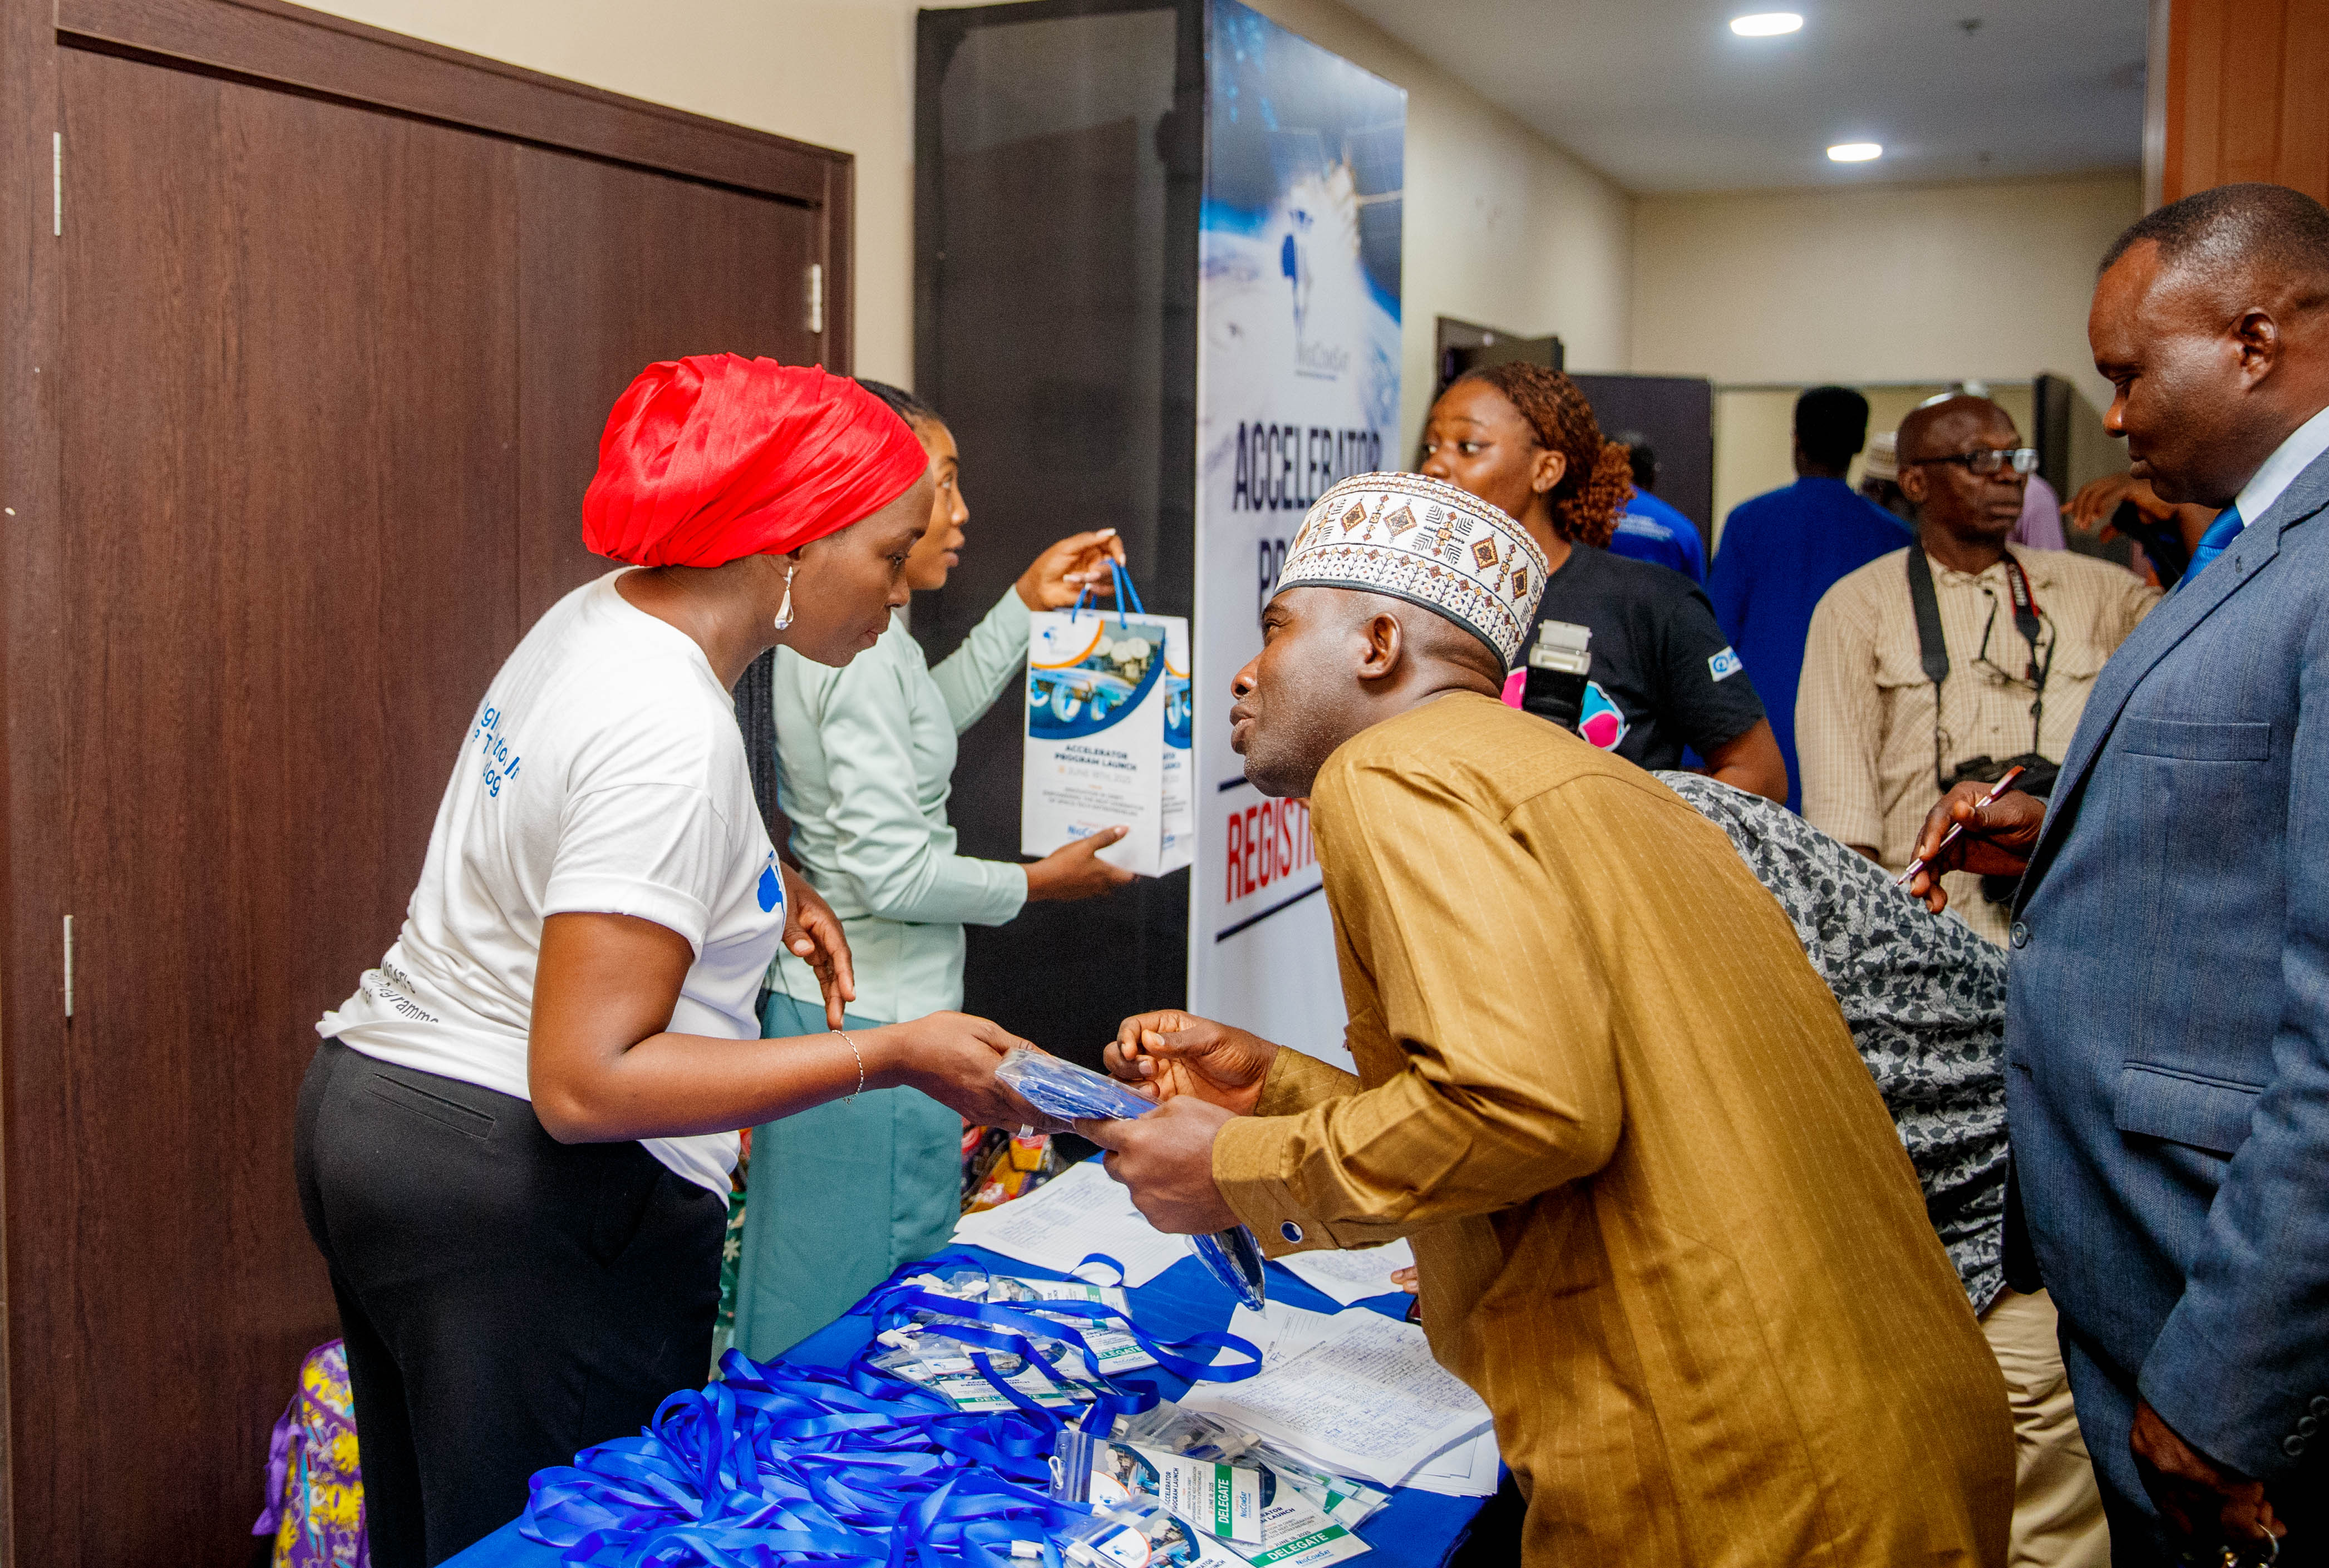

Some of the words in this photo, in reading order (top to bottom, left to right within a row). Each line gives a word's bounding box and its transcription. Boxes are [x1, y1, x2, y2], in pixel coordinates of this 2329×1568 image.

[1226, 797, 1315, 904] REGIST
[1097, 1345, 1144, 1359] ELEGATE
[1218, 1478, 1229, 1524] DELEGATE
[1267, 1508, 1296, 1520] LAUNCH
[1267, 1532, 1329, 1560] DELEGATE
